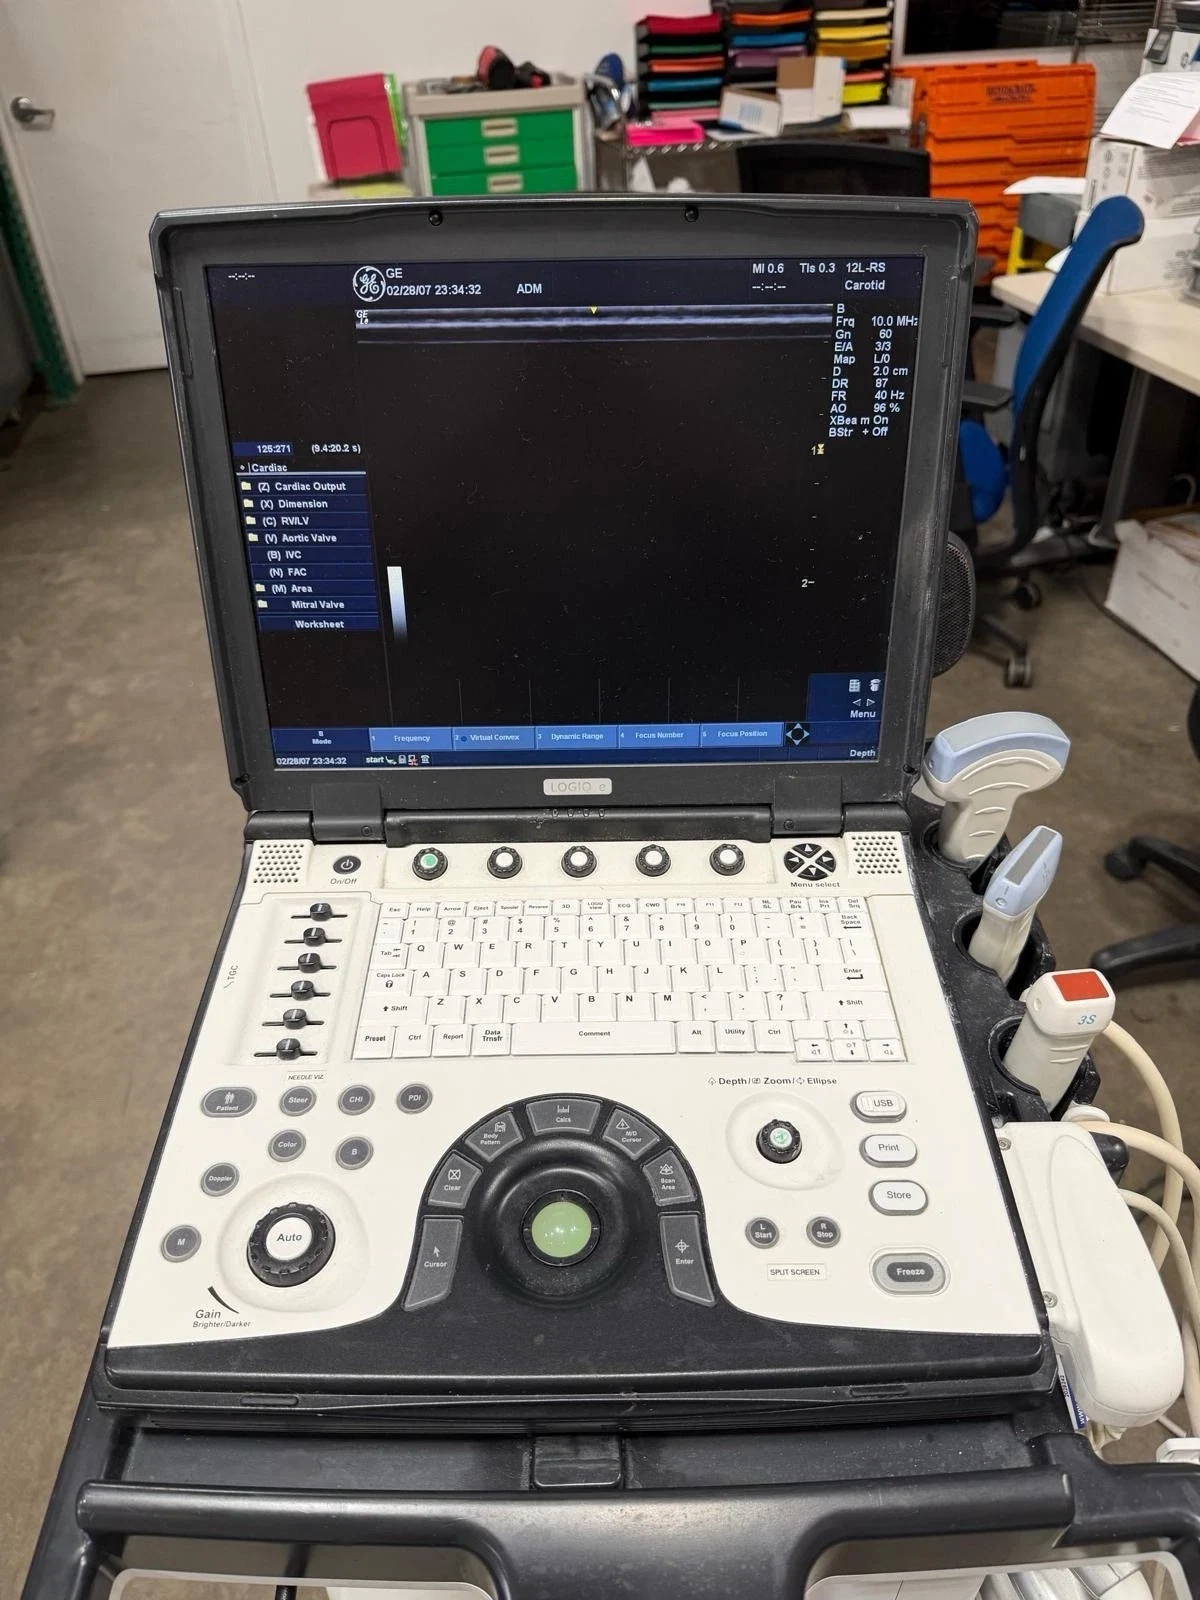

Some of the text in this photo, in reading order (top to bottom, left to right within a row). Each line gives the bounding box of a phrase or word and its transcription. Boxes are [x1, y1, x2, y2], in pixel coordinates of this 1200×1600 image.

[767, 263, 784, 274] 0.6
[818, 263, 835, 273] 0.3
[846, 262, 886, 273] 12L-RS
[386, 267, 403, 279] GE
[386, 284, 482, 296] 02/28/07 23:34:32
[516, 282, 542, 294] ADM
[844, 280, 886, 291] Carotid
[836, 304, 845, 313] B
[836, 316, 855, 328] Frq
[872, 316, 893, 326] 10.0
[835, 329, 892, 339] Gn 60
[834, 341, 891, 352] E/A 3/3
[833, 355, 856, 366] Map
[832, 366, 908, 376] D 2.0 cm
[832, 378, 888, 389] DR 87
[831, 391, 905, 401] FR 40 Hz
[830, 403, 900, 414] AO 96 %
[873, 415, 888, 425] On
[872, 427, 888, 437] Off
[257, 445, 291, 453] 125:271
[251, 463, 288, 472] Cardiac
[258, 482, 347, 493] (Z) Cardiac Output
[260, 500, 328, 510] (X) Dimension
[262, 517, 277, 527] (C)
[265, 533, 337, 544] (V) Aortic Valve
[267, 551, 302, 561] (B) IVC
[269, 568, 307, 578] (N) FAC
[271, 584, 313, 594] (M) Area
[291, 601, 345, 609] Mitral Valve
[295, 620, 345, 628] Worksheet
[850, 710, 876, 719] Menu
[394, 734, 431, 743] Frequency
[494, 733, 520, 741] Convex
[551, 732, 603, 741] Dynamic Range
[657, 731, 684, 739] Number
[850, 749, 876, 759] Depth
[276, 757, 347, 766] 02/28/07 23:34:32
[365, 756, 385, 764] start
[598, 783, 606, 792] e
[1077, 1014, 1097, 1026] 3S
[443, 1033, 464, 1041] Report
[724, 1028, 746, 1036] Utility
[807, 1076, 837, 1086] Ellipse
[288, 1096, 309, 1104] Steer
[349, 1095, 363, 1103] CHI
[873, 1098, 894, 1108] USB
[216, 1104, 239, 1112] Patient
[277, 1140, 297, 1148] Color
[878, 1143, 900, 1152] Print
[208, 1174, 232, 1183] Doppler
[443, 1184, 461, 1192] Clear
[886, 1190, 912, 1200] Store
[276, 1232, 303, 1243] Auto
[755, 1230, 773, 1239] Start
[816, 1230, 834, 1239] Stop
[178, 1238, 185, 1246] M
[675, 1258, 694, 1266] Enter
[770, 1268, 820, 1276] SPLIT SCREEN
[896, 1266, 925, 1276] Freeze
[195, 1308, 221, 1319] Gain
[192, 1320, 251, 1329] Brighter/Darker
